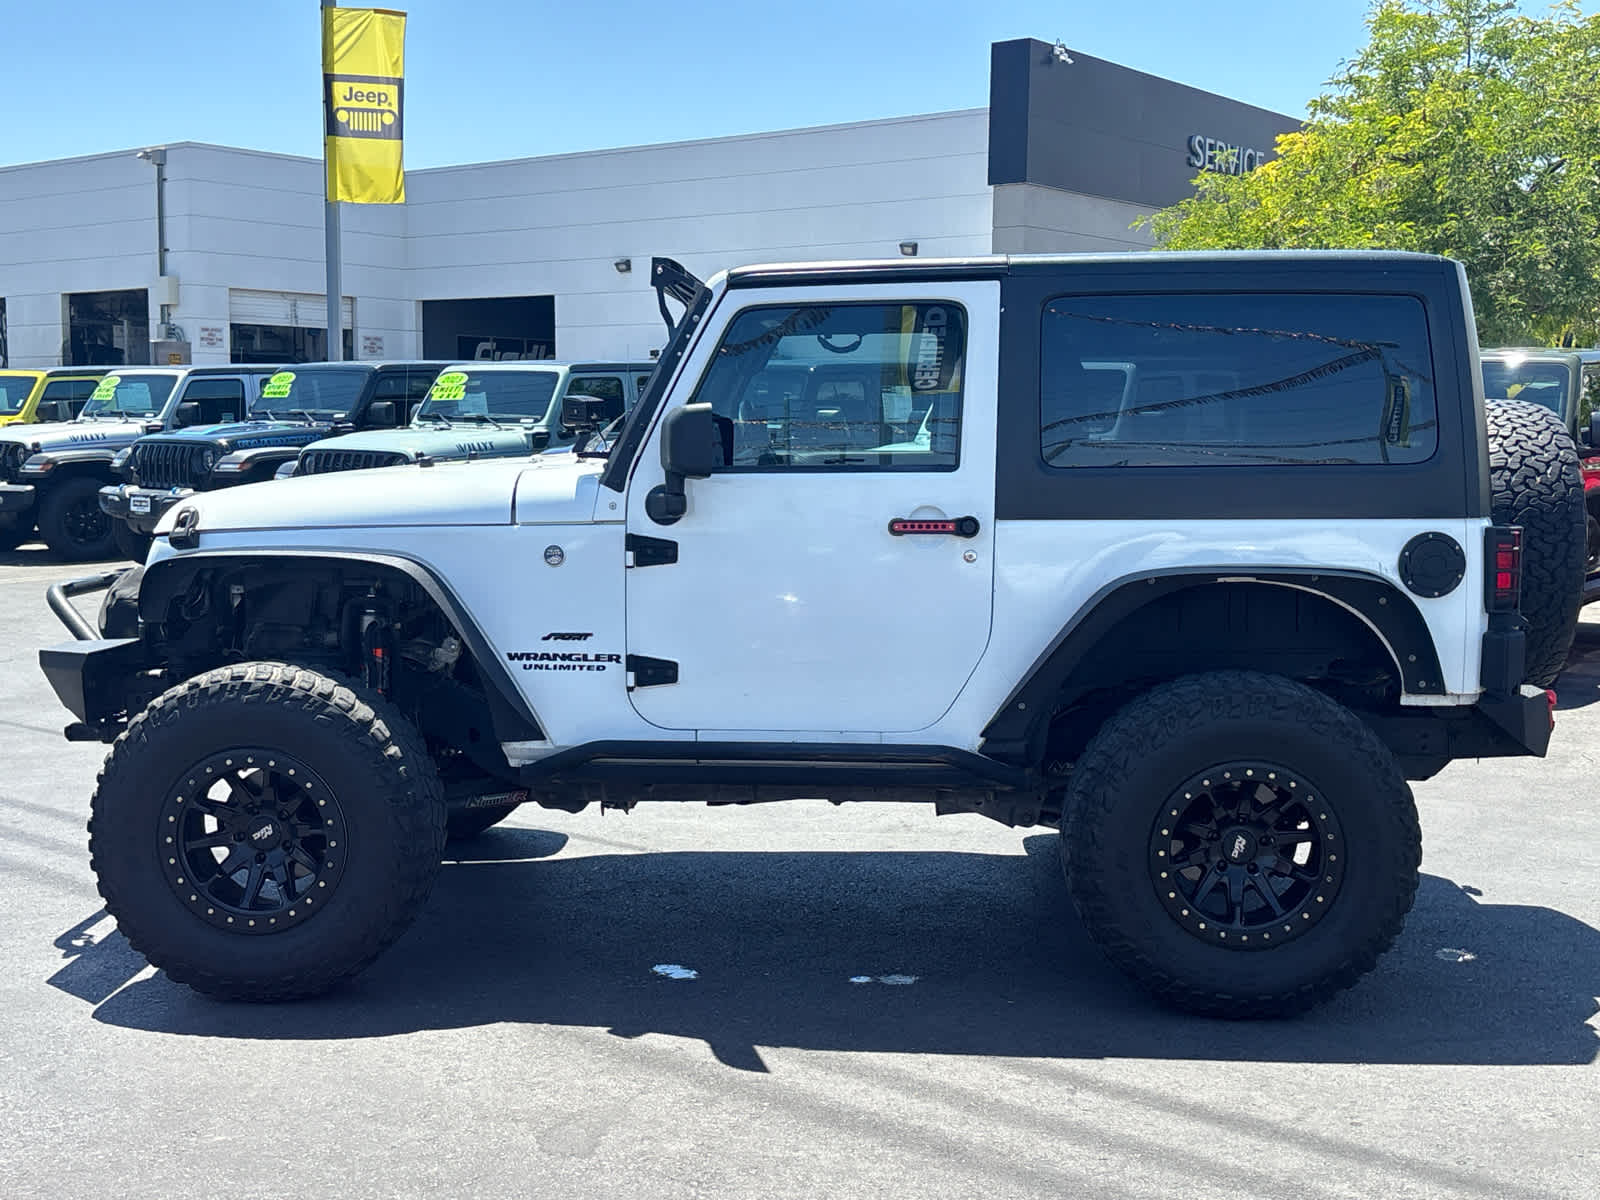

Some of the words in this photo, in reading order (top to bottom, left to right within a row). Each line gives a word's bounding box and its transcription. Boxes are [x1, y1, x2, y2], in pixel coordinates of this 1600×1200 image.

[342, 86, 389, 106] Jeep
[506, 652, 622, 664] WRANGLER
[522, 663, 606, 672] UNLIMITED
